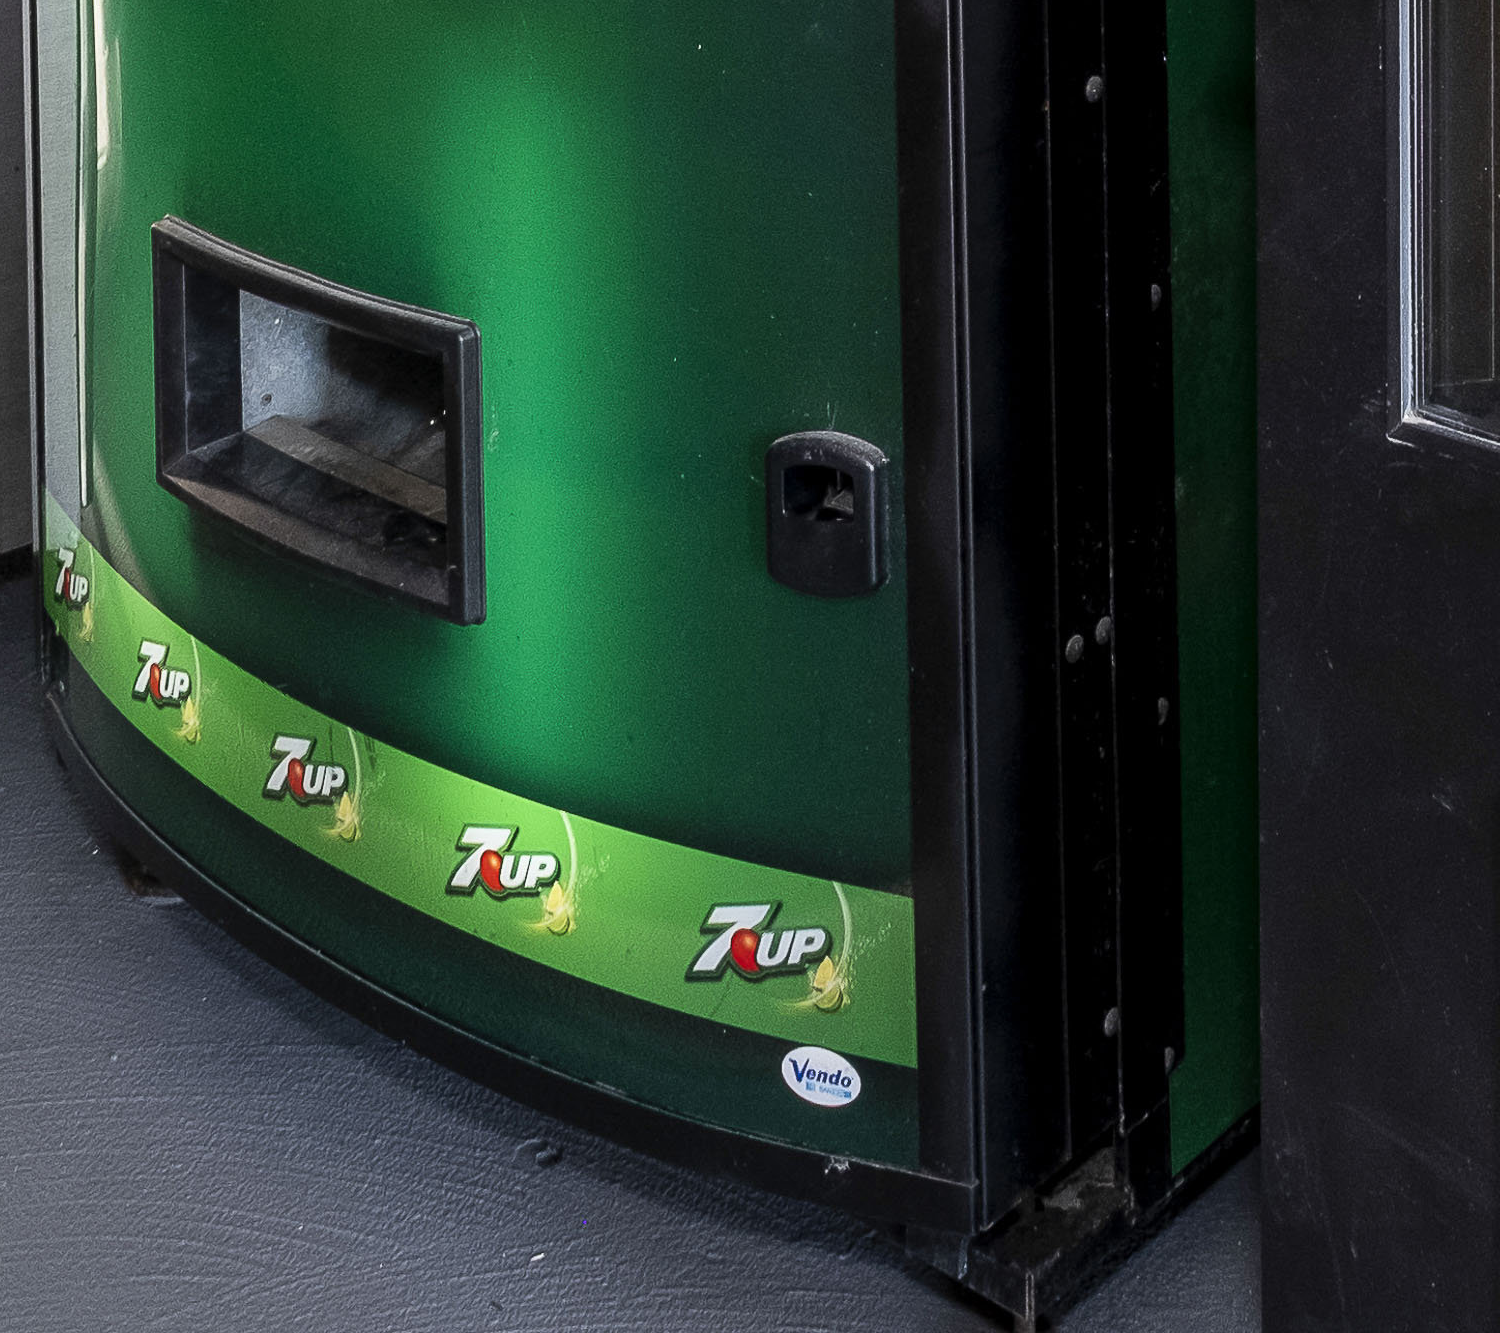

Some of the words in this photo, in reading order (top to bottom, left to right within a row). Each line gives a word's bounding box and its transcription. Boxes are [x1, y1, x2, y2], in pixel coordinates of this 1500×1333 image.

[54, 548, 90, 605] 7UP
[133, 641, 191, 703] 7UP
[264, 736, 346, 800] 7UP
[448, 826, 559, 896] 7UP
[689, 903, 830, 978] 7UP
[789, 1058, 852, 1088] Vendo
